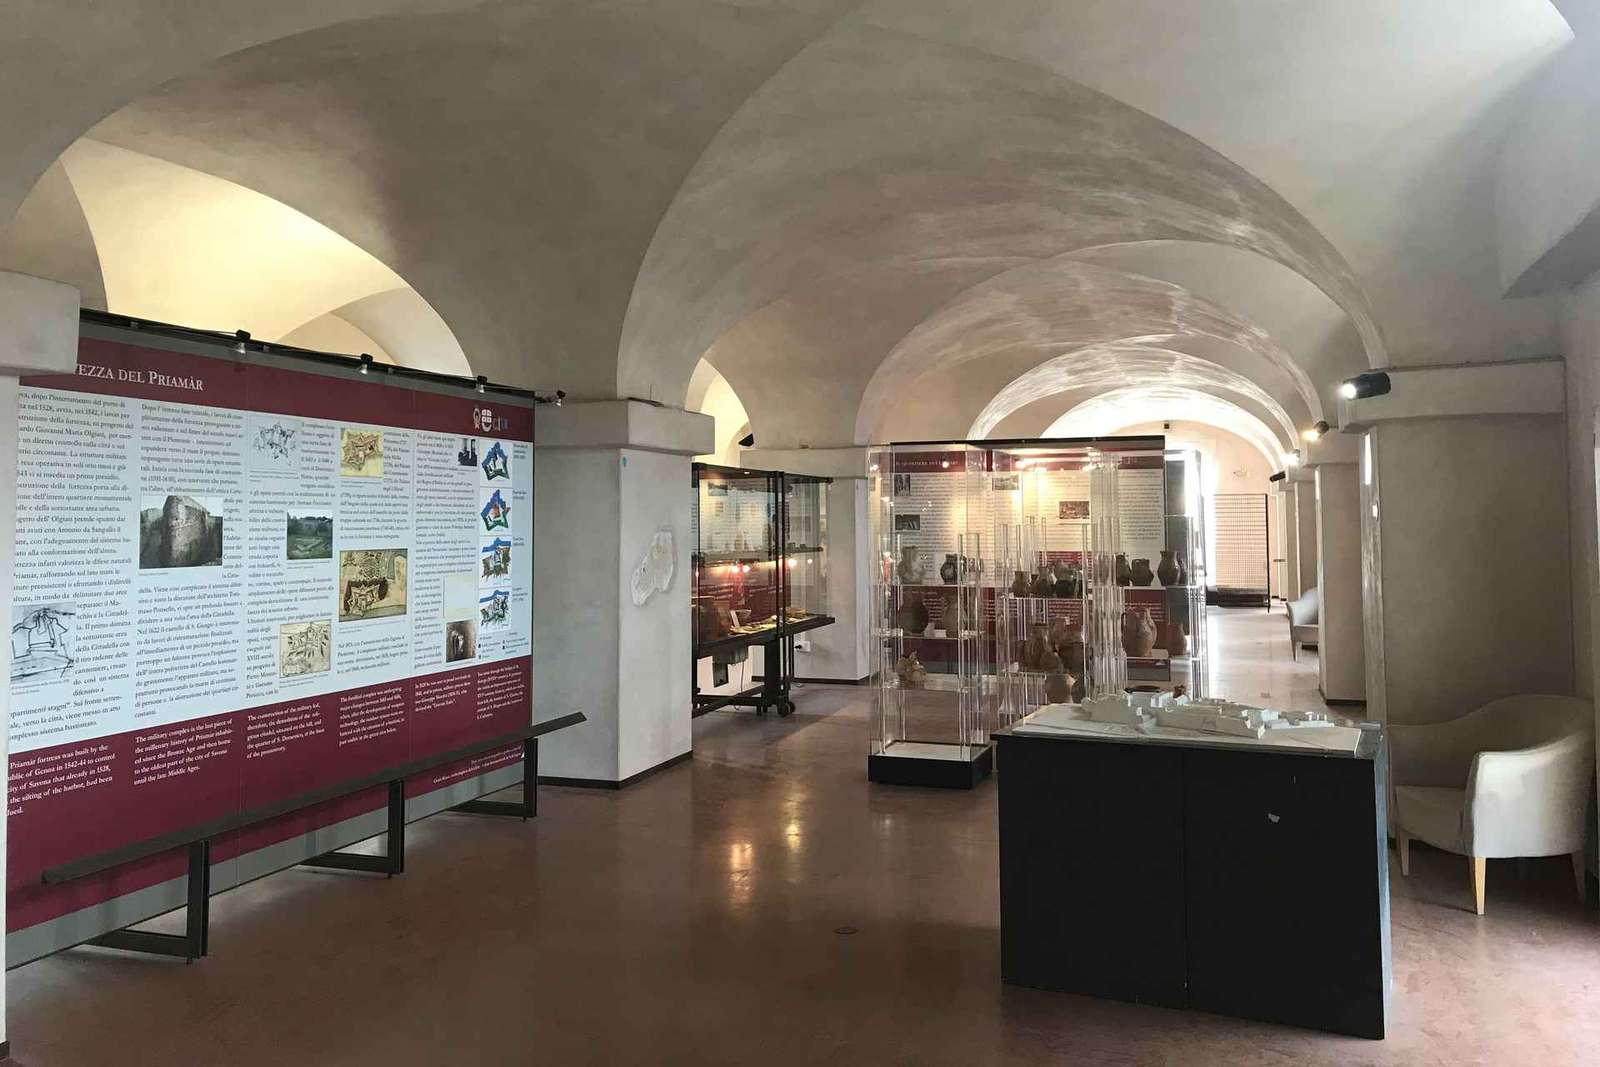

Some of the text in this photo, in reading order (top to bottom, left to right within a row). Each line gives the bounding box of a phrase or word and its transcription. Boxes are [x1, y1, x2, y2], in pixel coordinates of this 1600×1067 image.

[78, 364, 114, 378] EZZA
[118, 368, 145, 382] DEL
[35, 426, 63, 434] Giovanni
[84, 430, 106, 438] Olgiati,
[91, 641, 118, 650] Cittadella
[40, 726, 63, 735] sistema
[148, 732, 167, 740] military
[169, 727, 190, 736] complex
[214, 720, 226, 729] piece
[37, 754, 60, 764] fortress
[75, 747, 89, 756] built
[150, 761, 166, 770] oldest
[167, 759, 178, 768] part
[211, 748, 227, 756] Savona
[167, 748, 184, 756] Bronze
[35, 766, 55, 775] Genoa
[64, 758, 86, 769] 1542-44
[94, 752, 115, 762] control
[29, 778, 51, 788] Savona
[52, 774, 64, 783] that
[66, 769, 88, 780] already
[134, 776, 146, 784] until
[168, 767, 185, 776] Middle
[187, 764, 200, 773] Ages.
[22, 791, 42, 801] silting
[63, 782, 85, 791] harbor,
[86, 777, 97, 786] had
